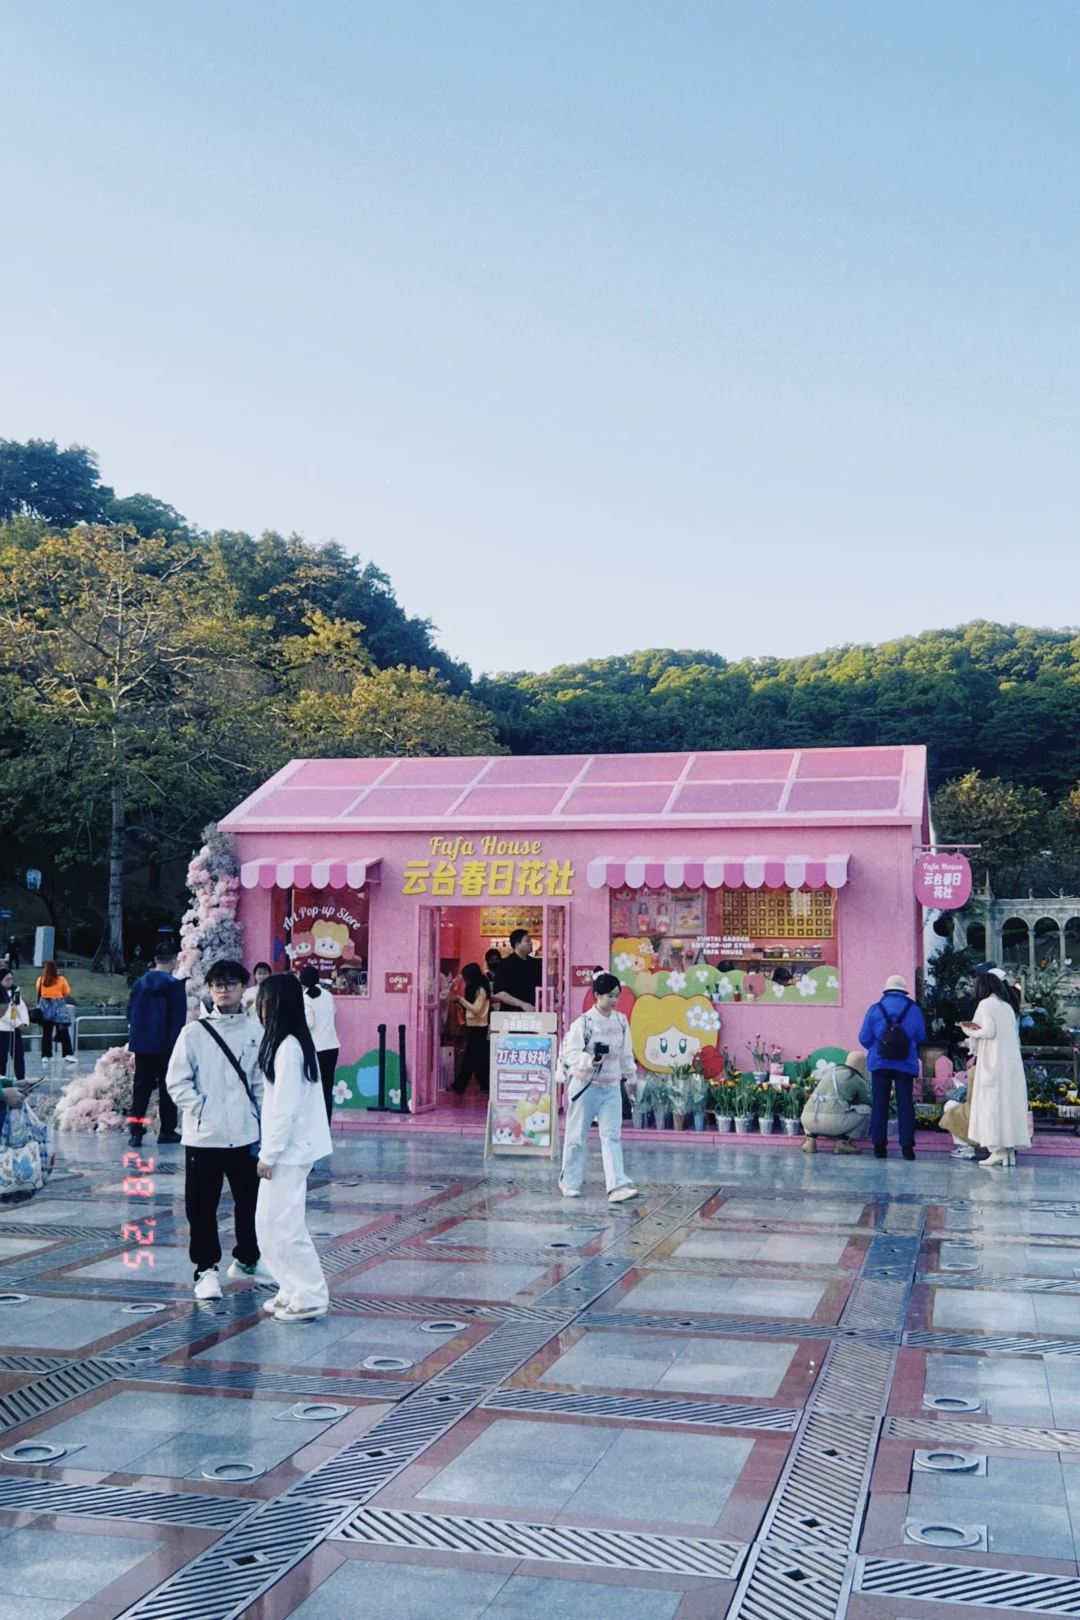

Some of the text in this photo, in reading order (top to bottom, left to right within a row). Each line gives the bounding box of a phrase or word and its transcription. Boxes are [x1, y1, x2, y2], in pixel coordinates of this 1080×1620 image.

[429, 836, 542, 861] Fafa House
[402, 860, 575, 896] 云台春日花社
[933, 886, 953, 898] 花社
[299, 906, 335, 918] Pop-up
[336, 907, 361, 930] Store
[497, 1049, 548, 1065] 打卡享好礼
